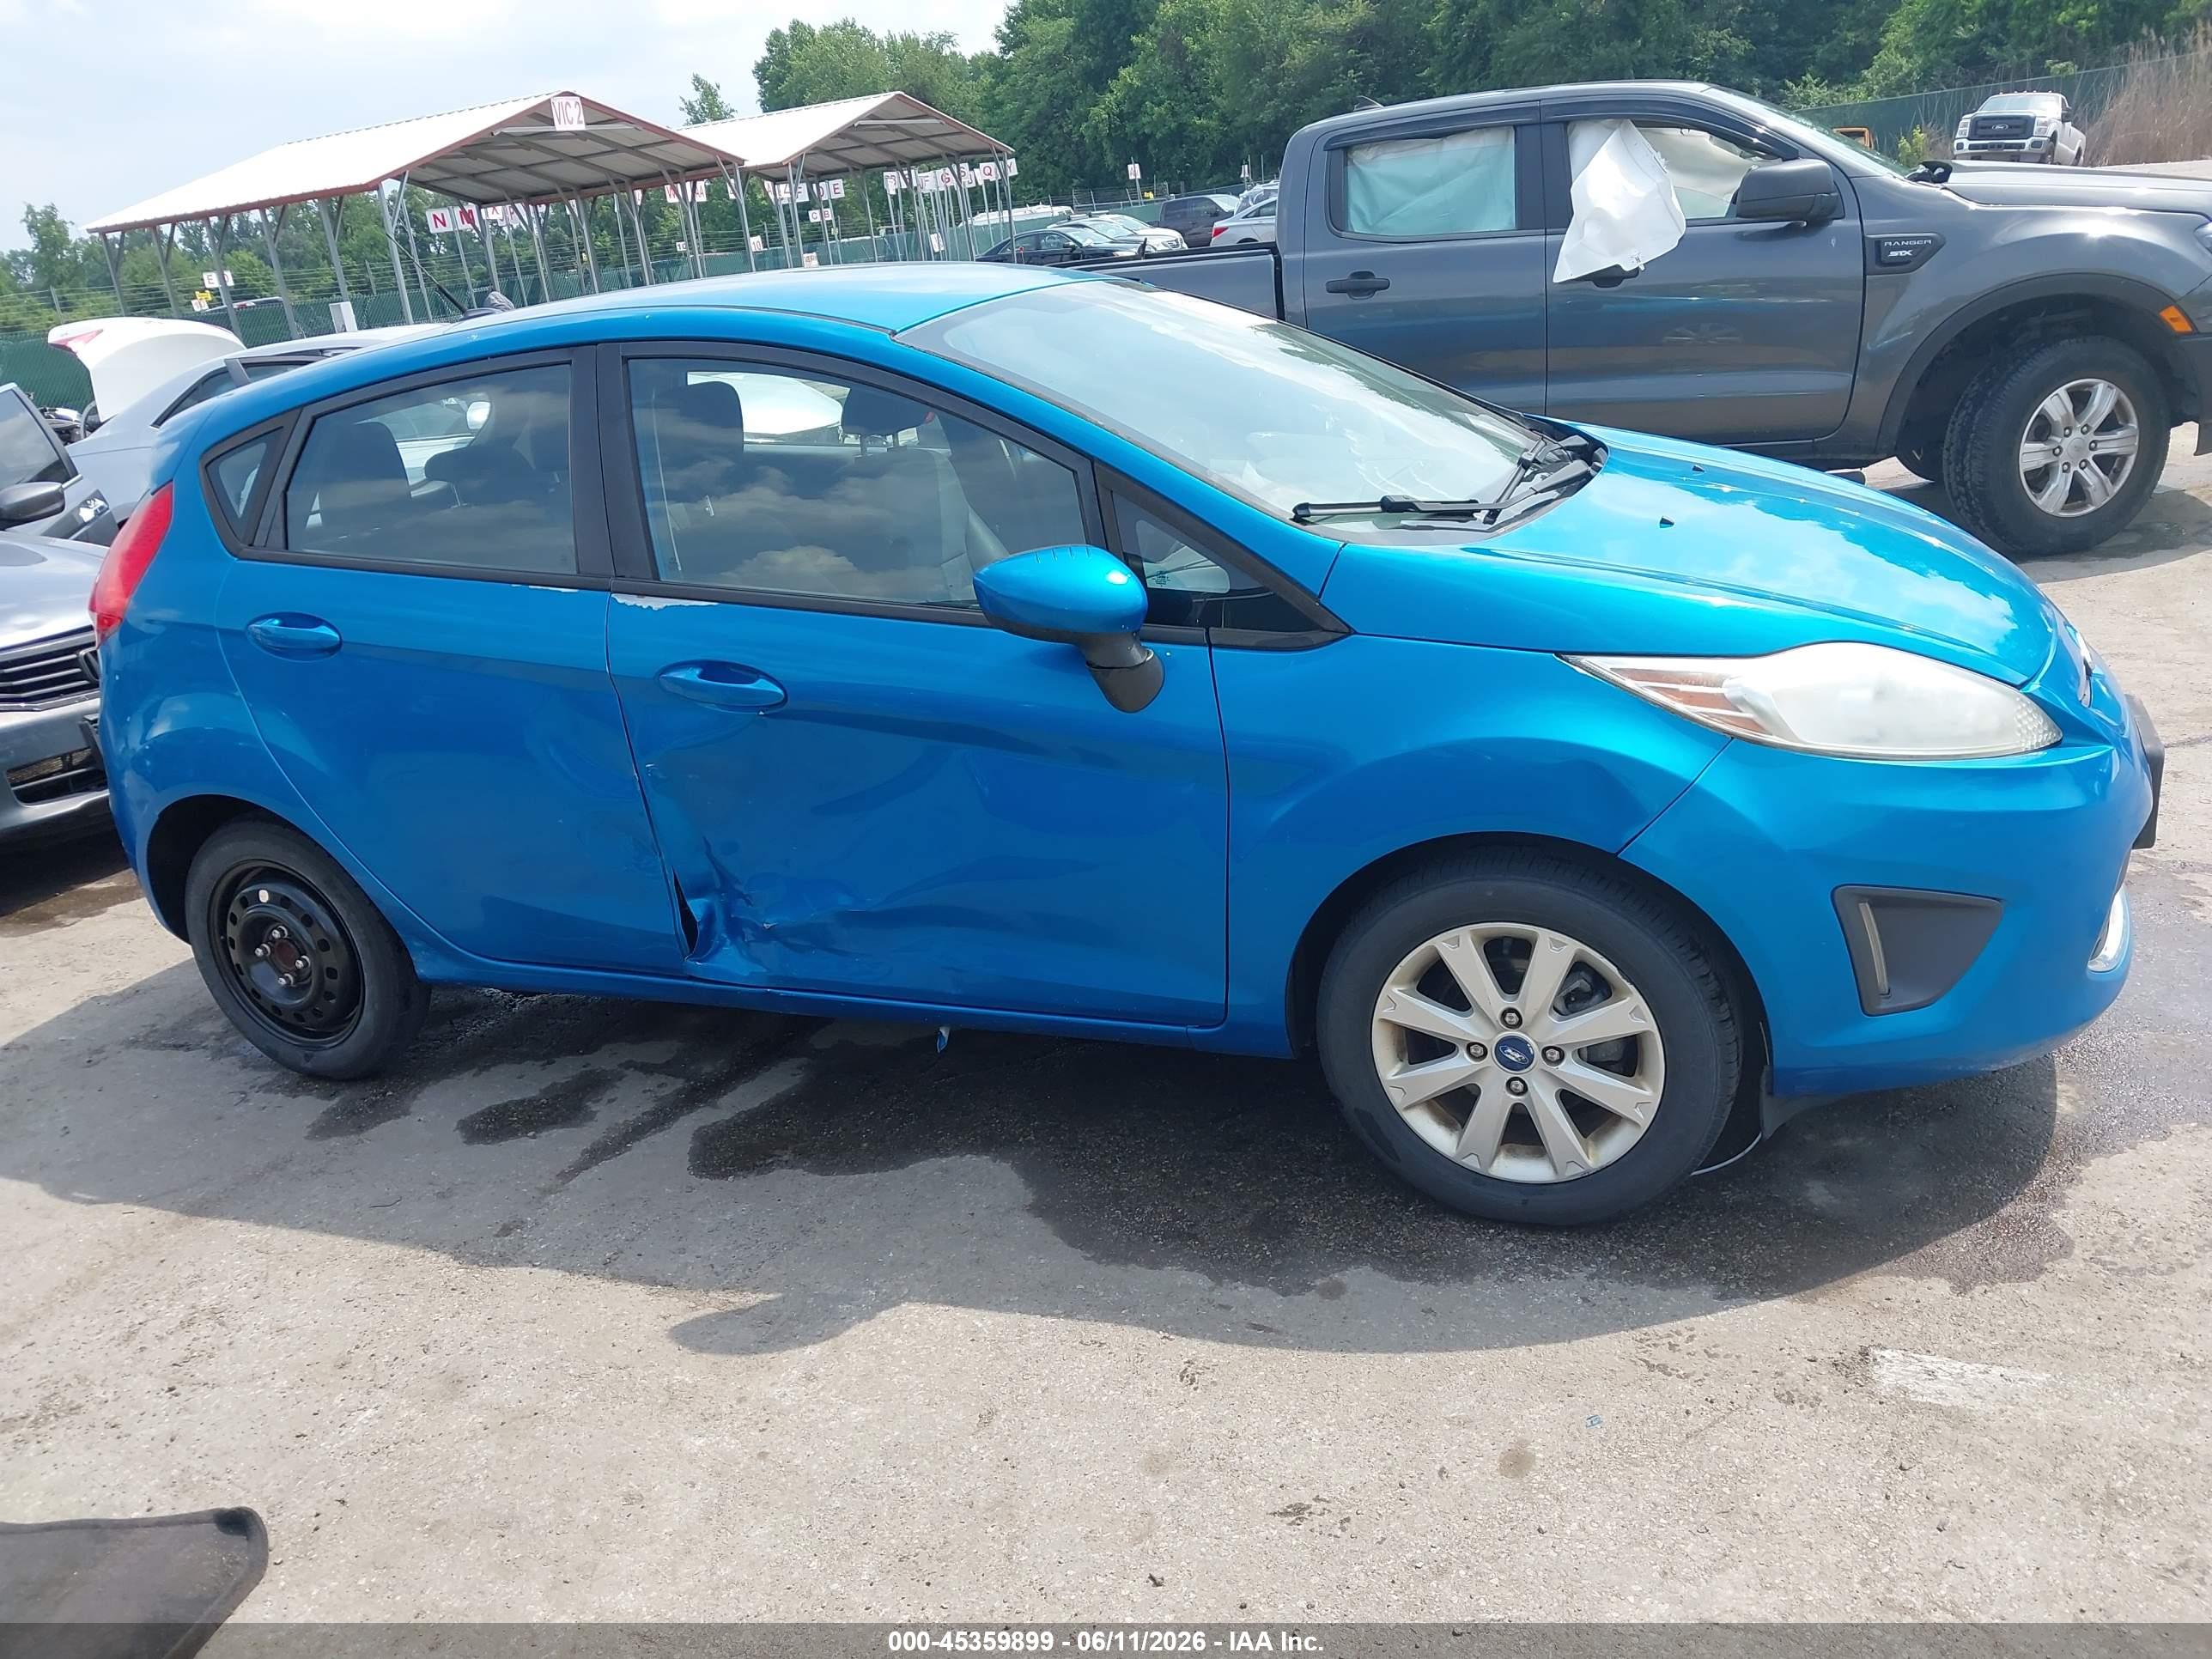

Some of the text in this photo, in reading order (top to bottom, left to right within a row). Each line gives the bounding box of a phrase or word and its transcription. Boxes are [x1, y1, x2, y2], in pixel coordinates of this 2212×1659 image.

[552, 101, 583, 125] VIC 2
[982, 165, 993, 176] Q
[940, 172, 951, 183] G
[832, 183, 841, 195] E
[459, 209, 476, 225] M
[811, 211, 818, 220] C
[824, 210, 830, 218] B
[432, 212, 447, 228] N
[1887, 249, 1914, 258] STX
[206, 274, 216, 284] E
